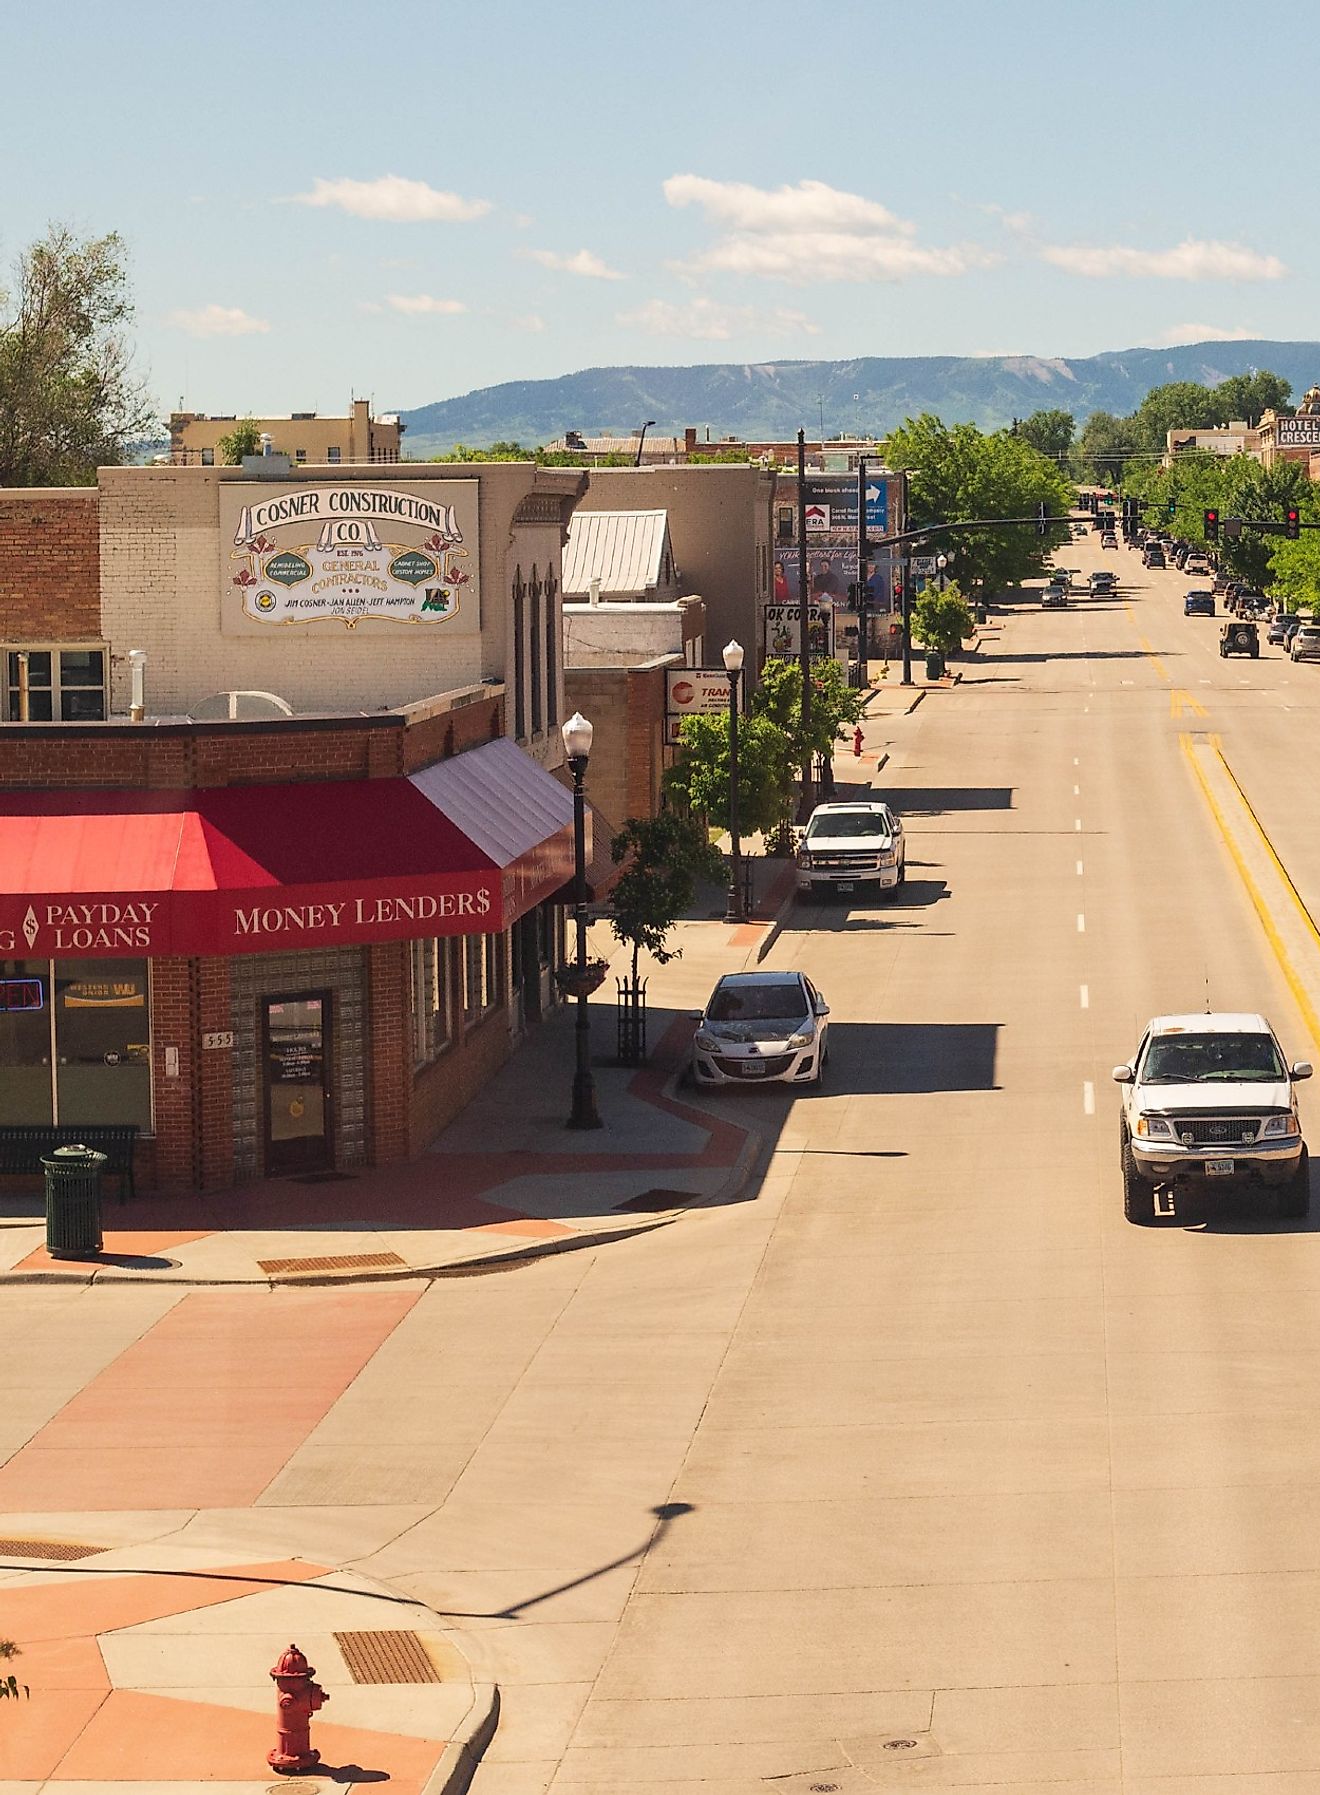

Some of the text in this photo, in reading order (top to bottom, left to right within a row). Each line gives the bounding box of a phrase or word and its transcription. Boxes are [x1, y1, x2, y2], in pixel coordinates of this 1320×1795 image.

[1280, 419, 1319, 431] HOTEL
[256, 491, 441, 527] COSNER CONSTRUCTION
[337, 523, 361, 542] CO.
[322, 560, 381, 571] GENERAL
[311, 573, 388, 594] CONTRACTORS
[285, 600, 299, 608] JIM
[299, 599, 326, 608] COSNER
[368, 598, 384, 606] JEFF
[768, 608, 784, 621] OK
[701, 688, 730, 697] TRAN
[46, 902, 160, 926] PAYDAY
[233, 902, 346, 936] MONEY
[354, 886, 491, 924] LENDER$
[25, 918, 36, 936] $
[55, 926, 151, 950] LOANS
